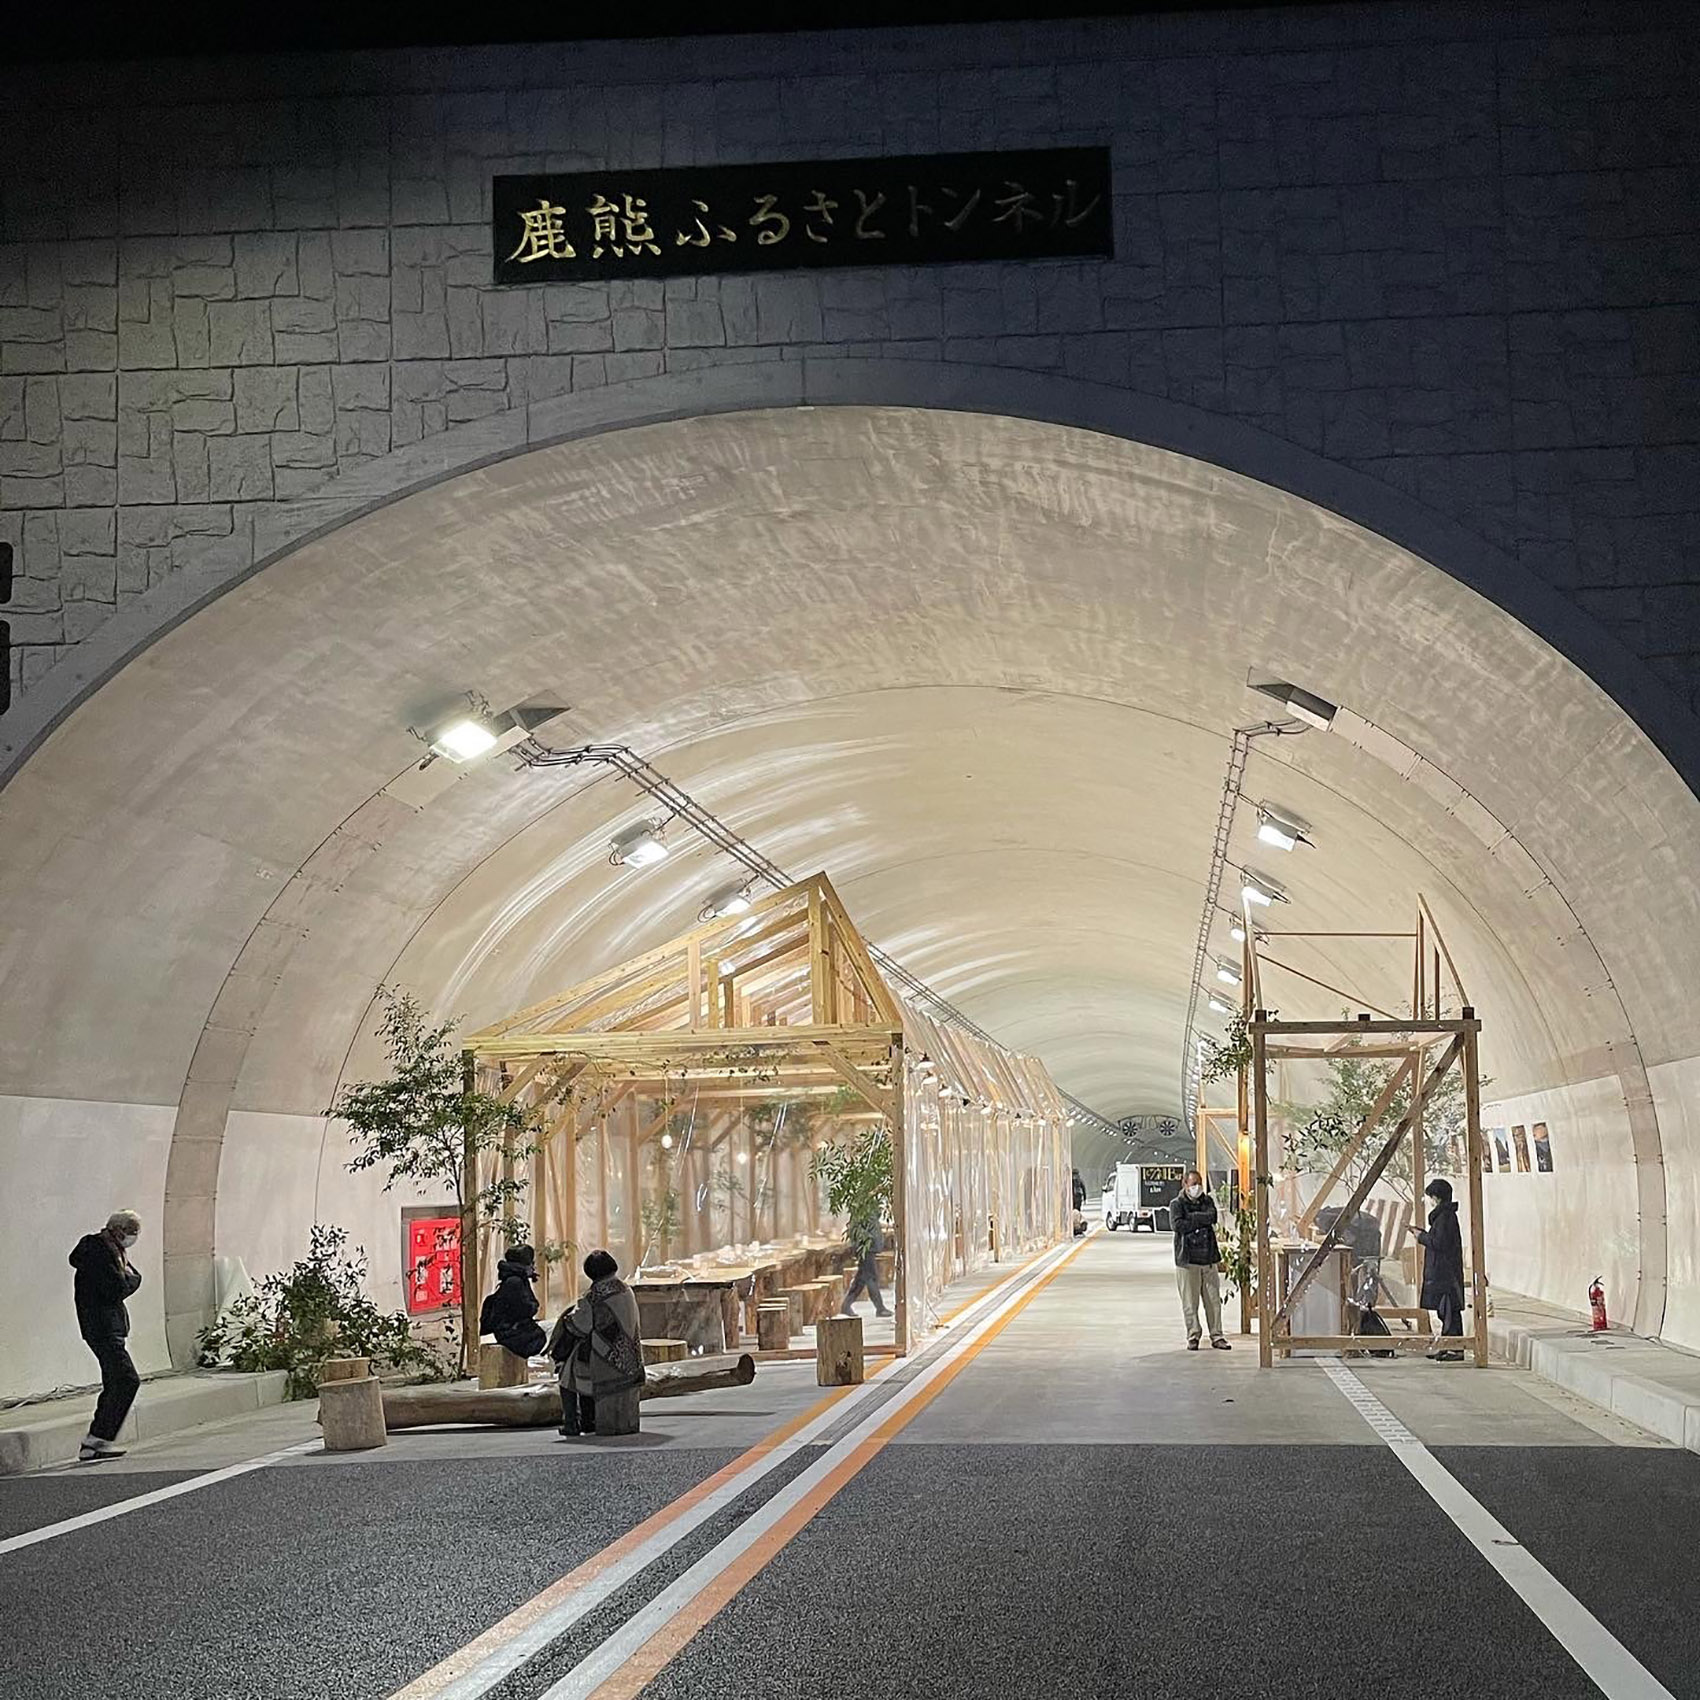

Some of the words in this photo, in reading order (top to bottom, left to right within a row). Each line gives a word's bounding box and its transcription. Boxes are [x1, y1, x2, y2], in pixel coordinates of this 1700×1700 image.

[504, 178, 1101, 265] 鹿熊ふるさとトンネル
